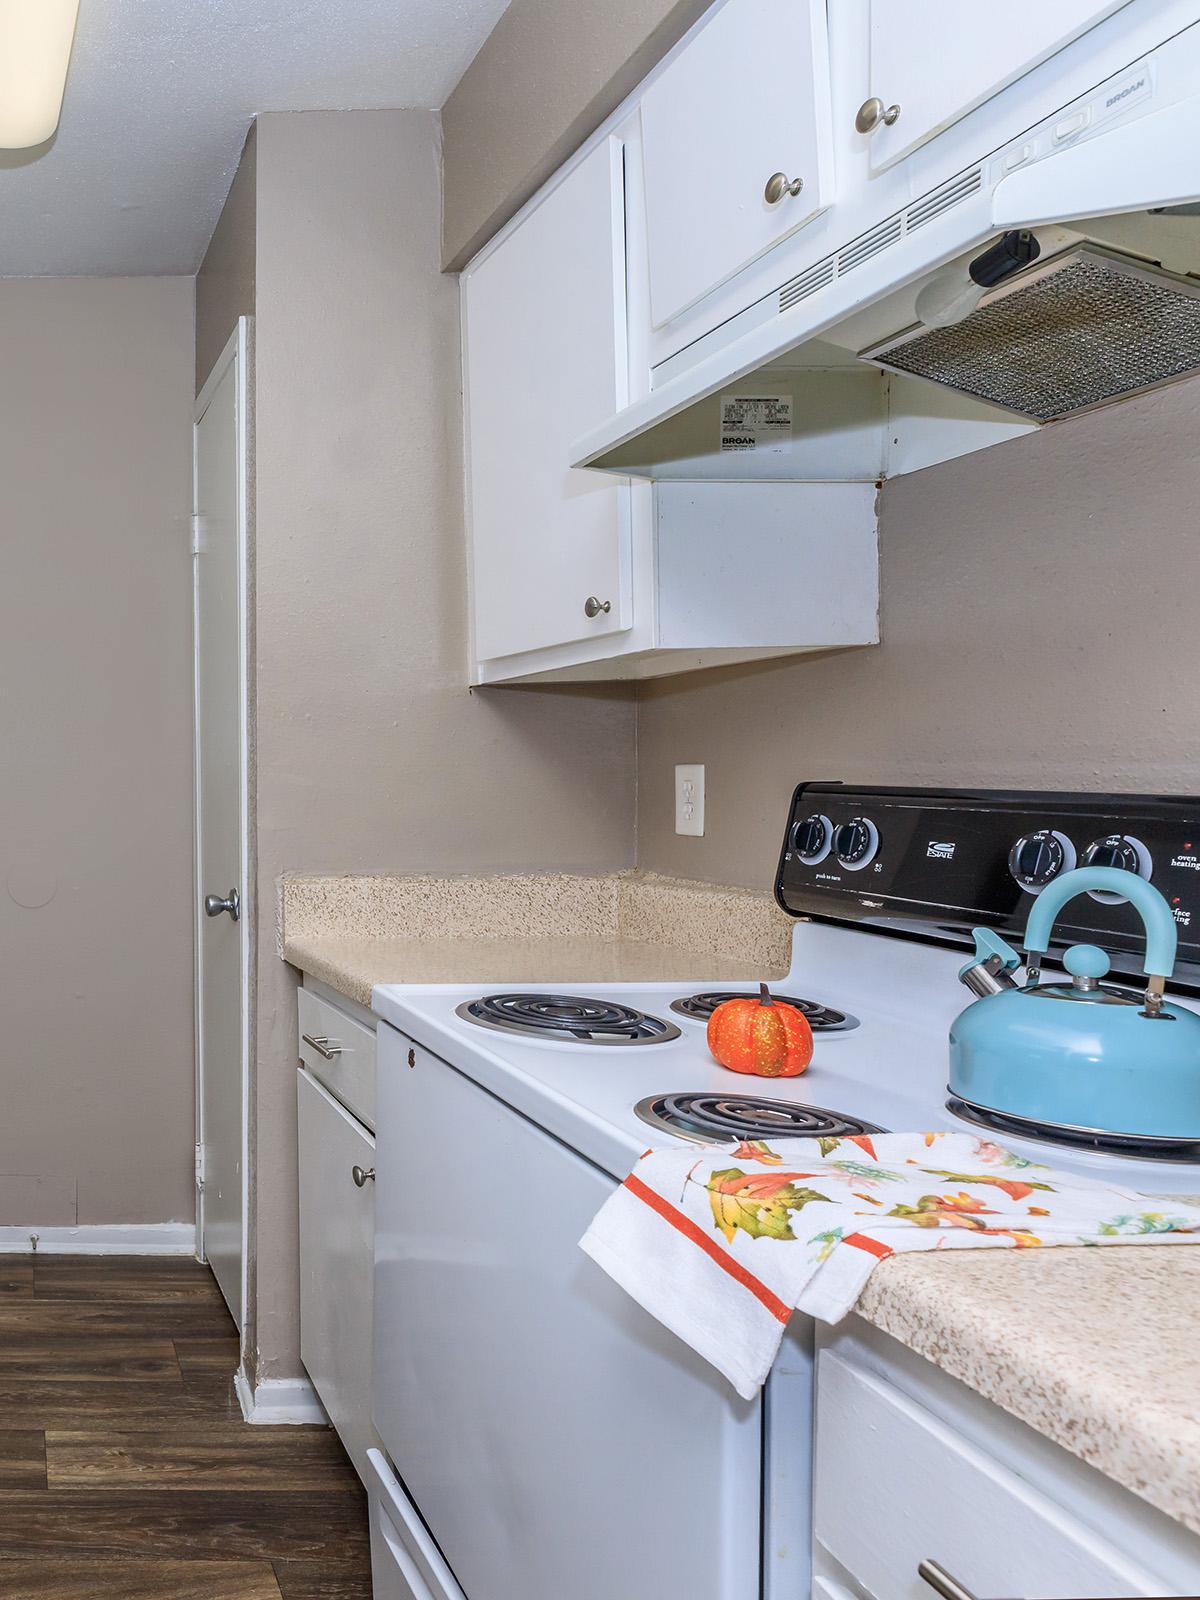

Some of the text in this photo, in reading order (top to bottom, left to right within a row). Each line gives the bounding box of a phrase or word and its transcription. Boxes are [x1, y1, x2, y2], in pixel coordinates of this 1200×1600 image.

[1106, 79, 1144, 107] BROAN
[722, 437, 756, 445] BROAN
[926, 850, 954, 859] ESTATE
[1170, 858, 1200, 871] heating
